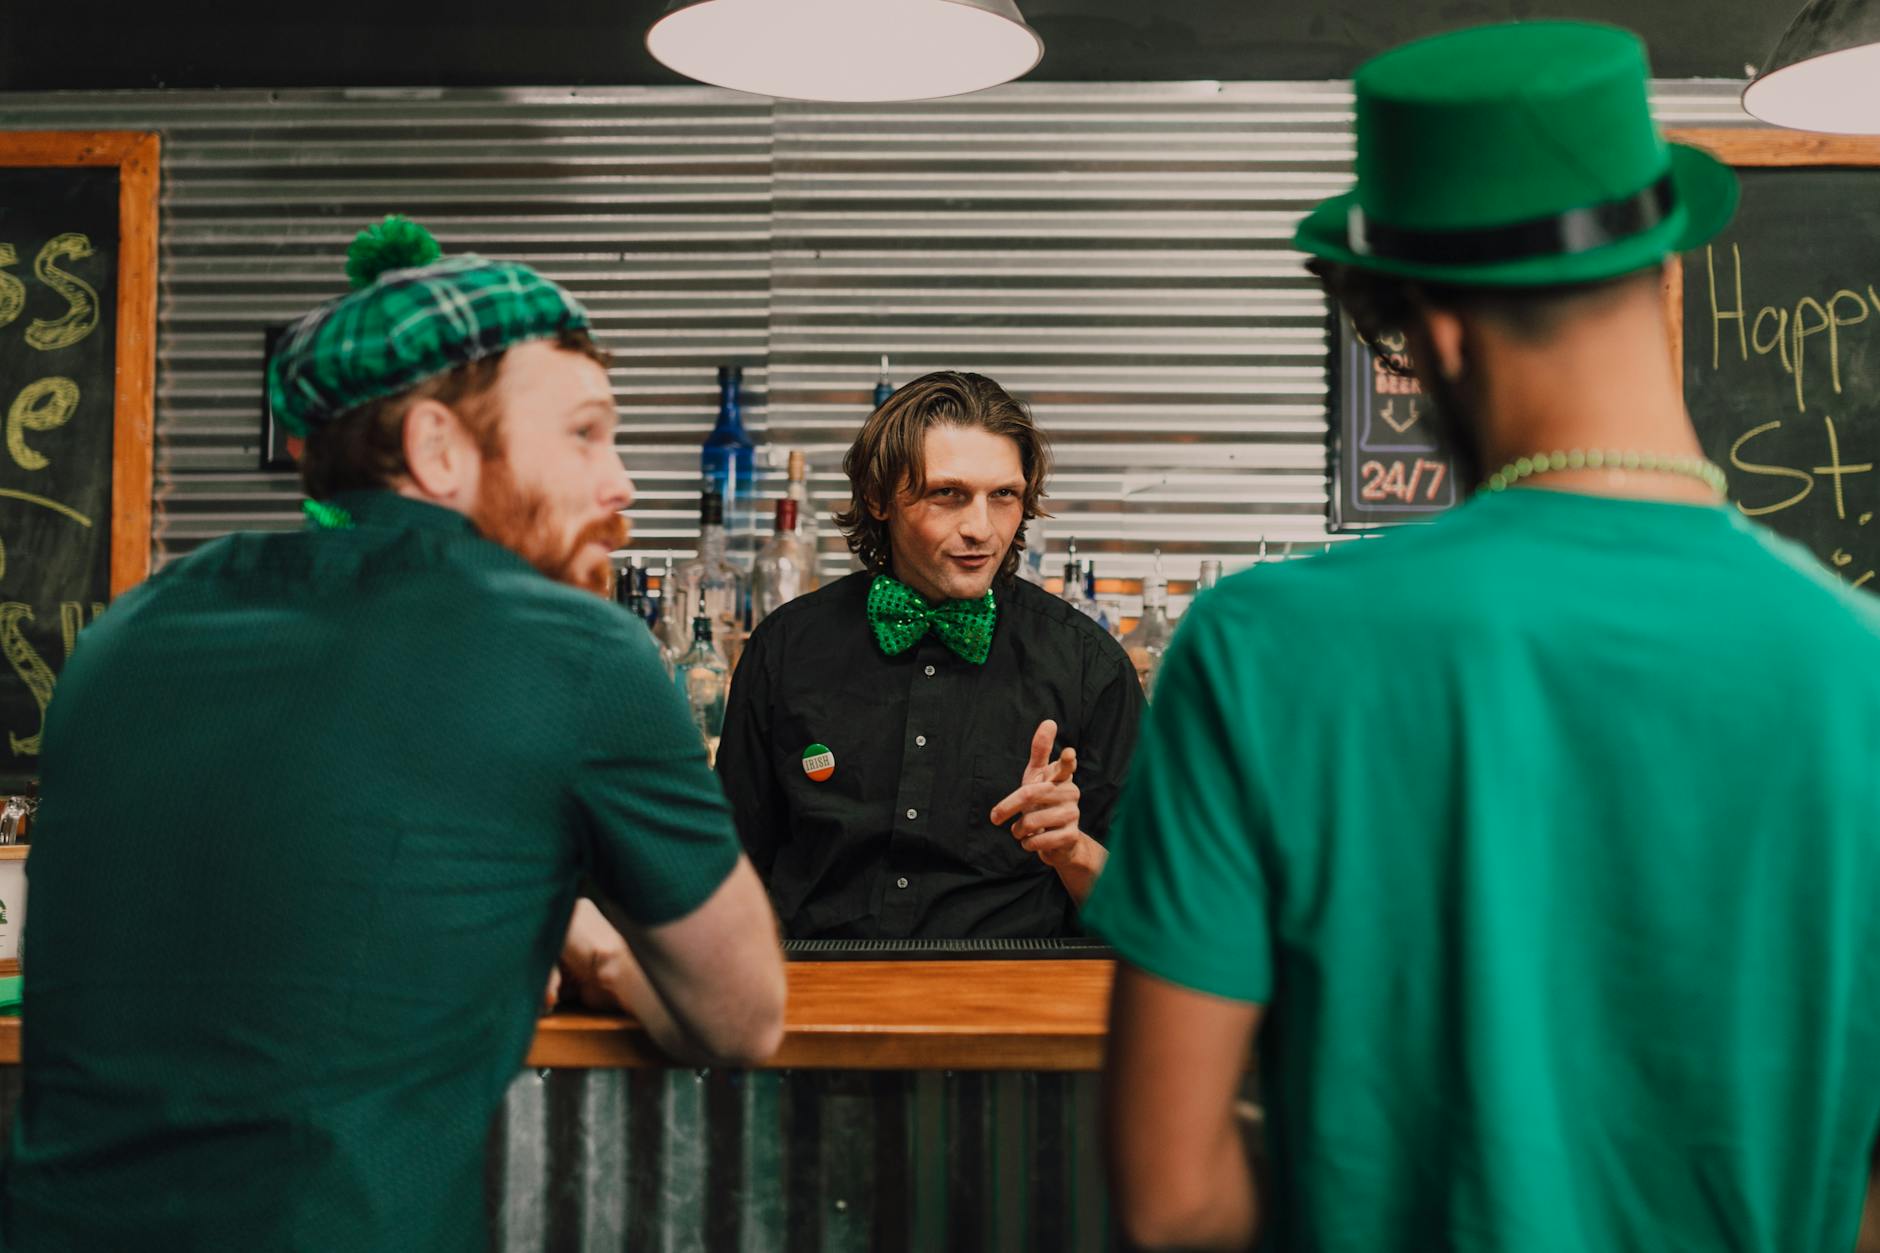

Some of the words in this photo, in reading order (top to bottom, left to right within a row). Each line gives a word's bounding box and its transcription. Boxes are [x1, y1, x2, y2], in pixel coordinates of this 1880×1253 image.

[1707, 242, 1880, 413] Happ
[1361, 458, 1447, 503] 24/7
[1730, 415, 1873, 525] St.
[805, 755, 830, 771] IRISH
